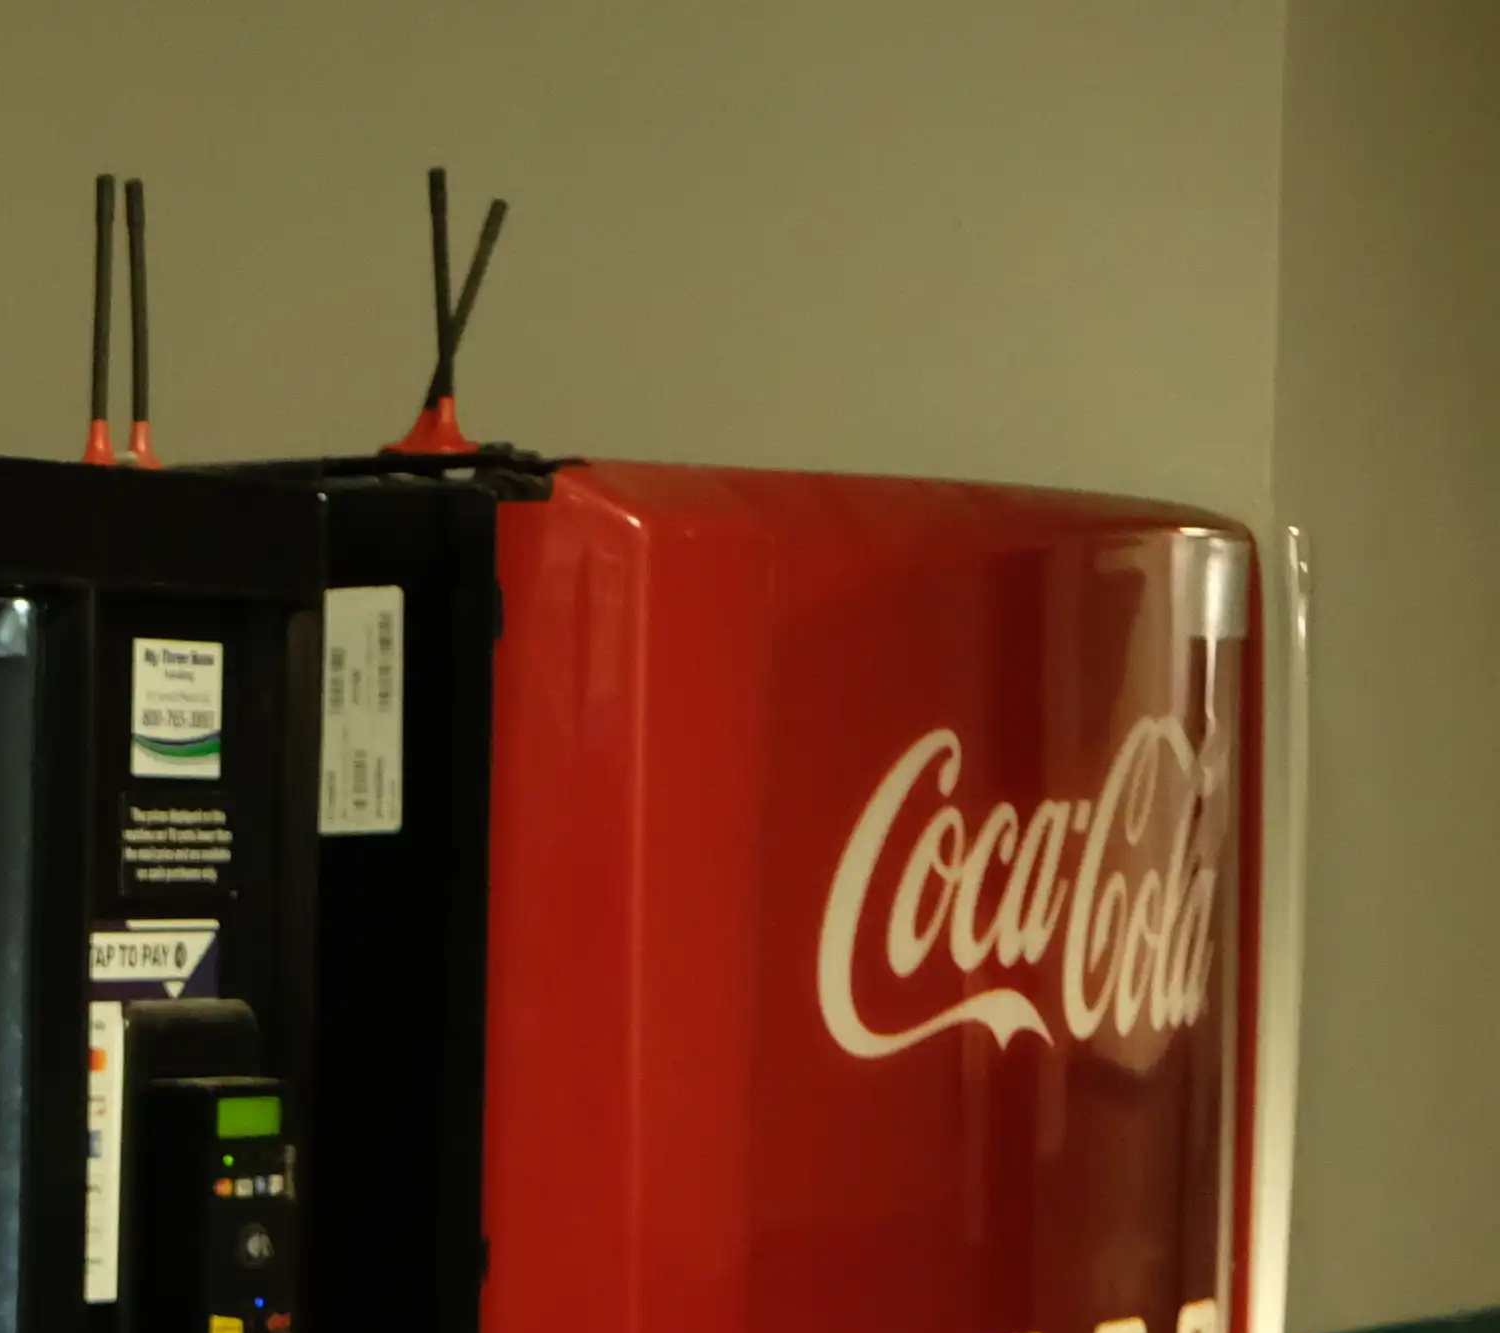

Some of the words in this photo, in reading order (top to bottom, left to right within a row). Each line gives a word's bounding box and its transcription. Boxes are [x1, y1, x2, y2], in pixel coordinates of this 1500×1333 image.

[119, 943, 139, 967] TO
[142, 942, 171, 967] PAY
[817, 716, 1216, 1059] Coca-Cola
